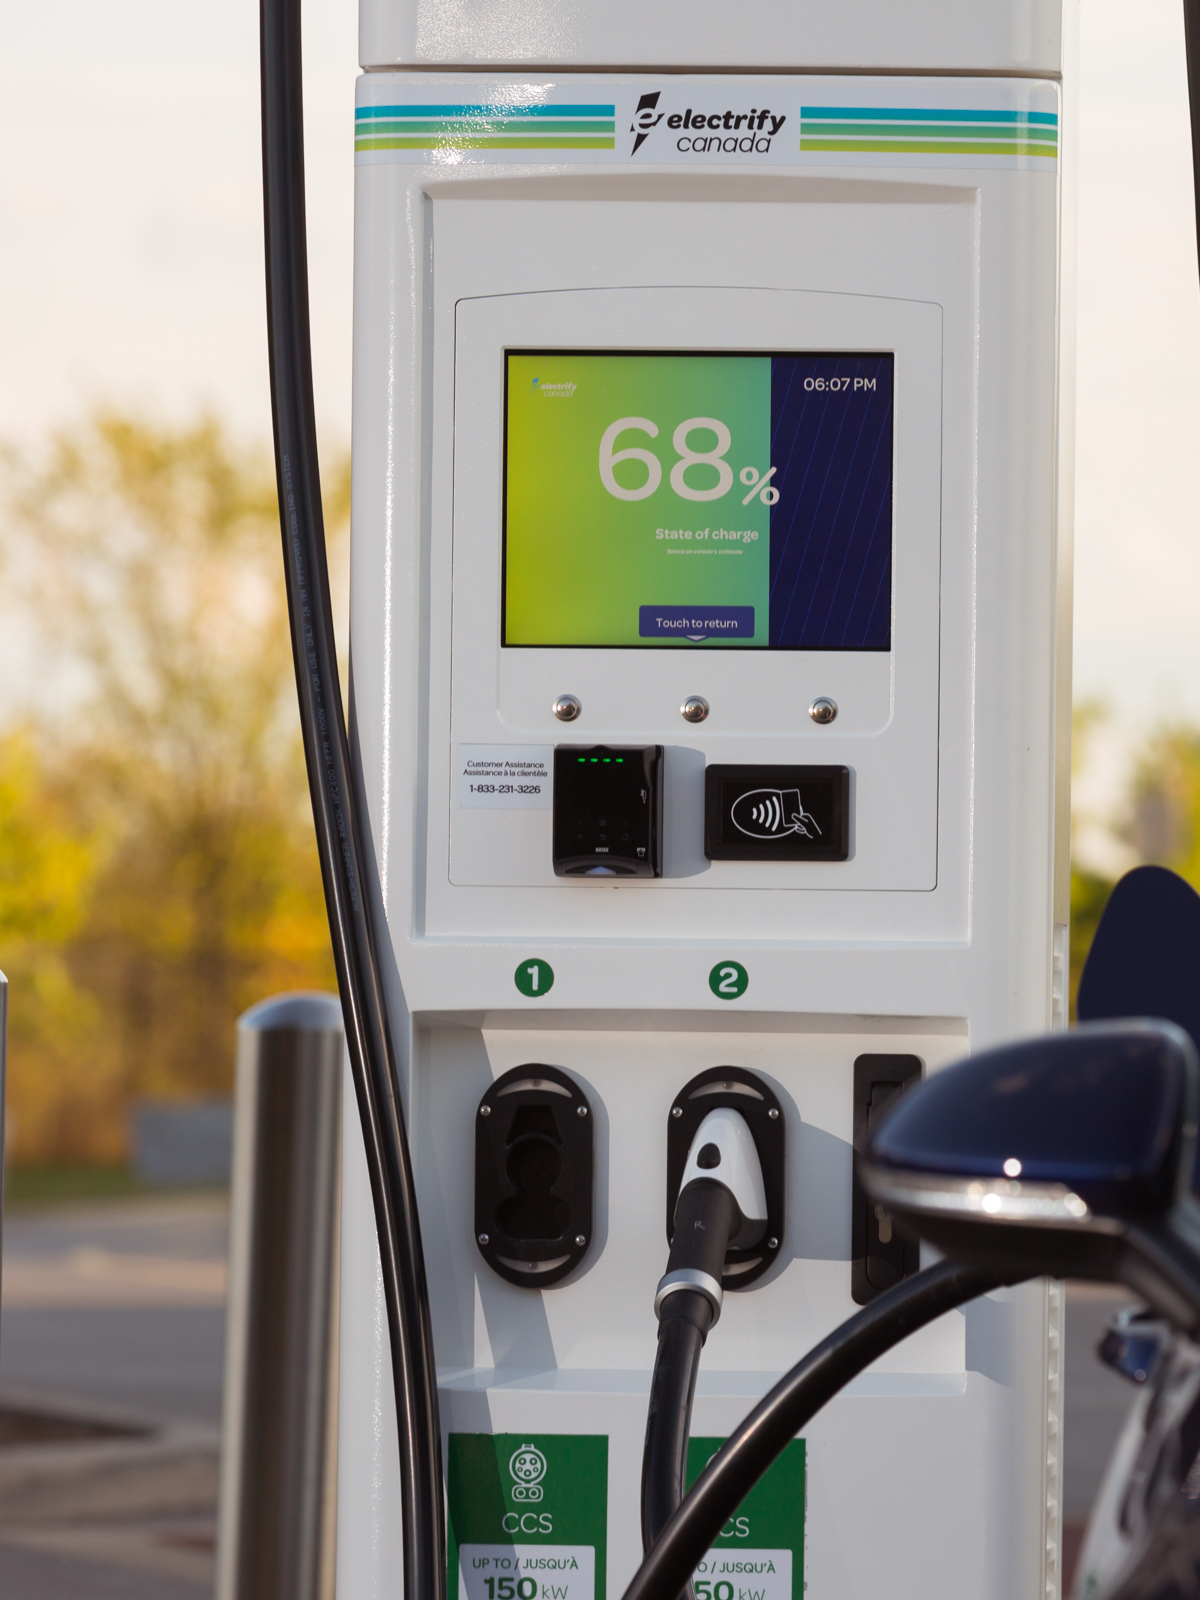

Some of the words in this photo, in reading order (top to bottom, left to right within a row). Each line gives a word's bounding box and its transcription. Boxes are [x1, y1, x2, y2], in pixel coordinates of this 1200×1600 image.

[667, 109, 786, 136] electrify
[676, 132, 772, 153] canada
[541, 382, 577, 392] electrify
[803, 377, 850, 392] 06:07
[854, 378, 877, 391] PM
[283, 455, 292, 489] SYSTEM
[288, 494, 298, 534] COOLING
[655, 527, 693, 540] State
[695, 527, 710, 540] of
[712, 527, 759, 543] charge
[293, 539, 305, 584] APPROVED
[300, 589, 307, 601] AN
[302, 606, 310, 617] IN
[656, 618, 690, 628] Touch
[691, 619, 703, 628] to
[704, 619, 738, 628] return
[305, 623, 314, 646] ONLY
[308, 651, 317, 669] USE
[312, 673, 321, 692] FOR
[318, 707, 328, 735] 1000V
[463, 769, 502, 777] Assistance
[503, 769, 508, 777] à
[509, 769, 516, 777] la
[516, 769, 548, 778] clientèle
[467, 760, 503, 768] Customer
[504, 761, 544, 769] Assistance
[328, 770, 340, 804] HPC400
[469, 784, 541, 794] 1-833-231-3226
[335, 808, 347, 837] RADOX
[526, 965, 539, 991] 1
[718, 967, 739, 993] 2
[502, 1512, 553, 1534] CCS
[720, 1516, 750, 1538] CS
[472, 1557, 490, 1569] UP
[493, 1557, 511, 1570] TO
[697, 1561, 708, 1573] O
[483, 1576, 538, 1600] 150
[541, 1584, 569, 1600] kW
[694, 1580, 734, 1600] 50
[738, 1588, 766, 1600] kW
